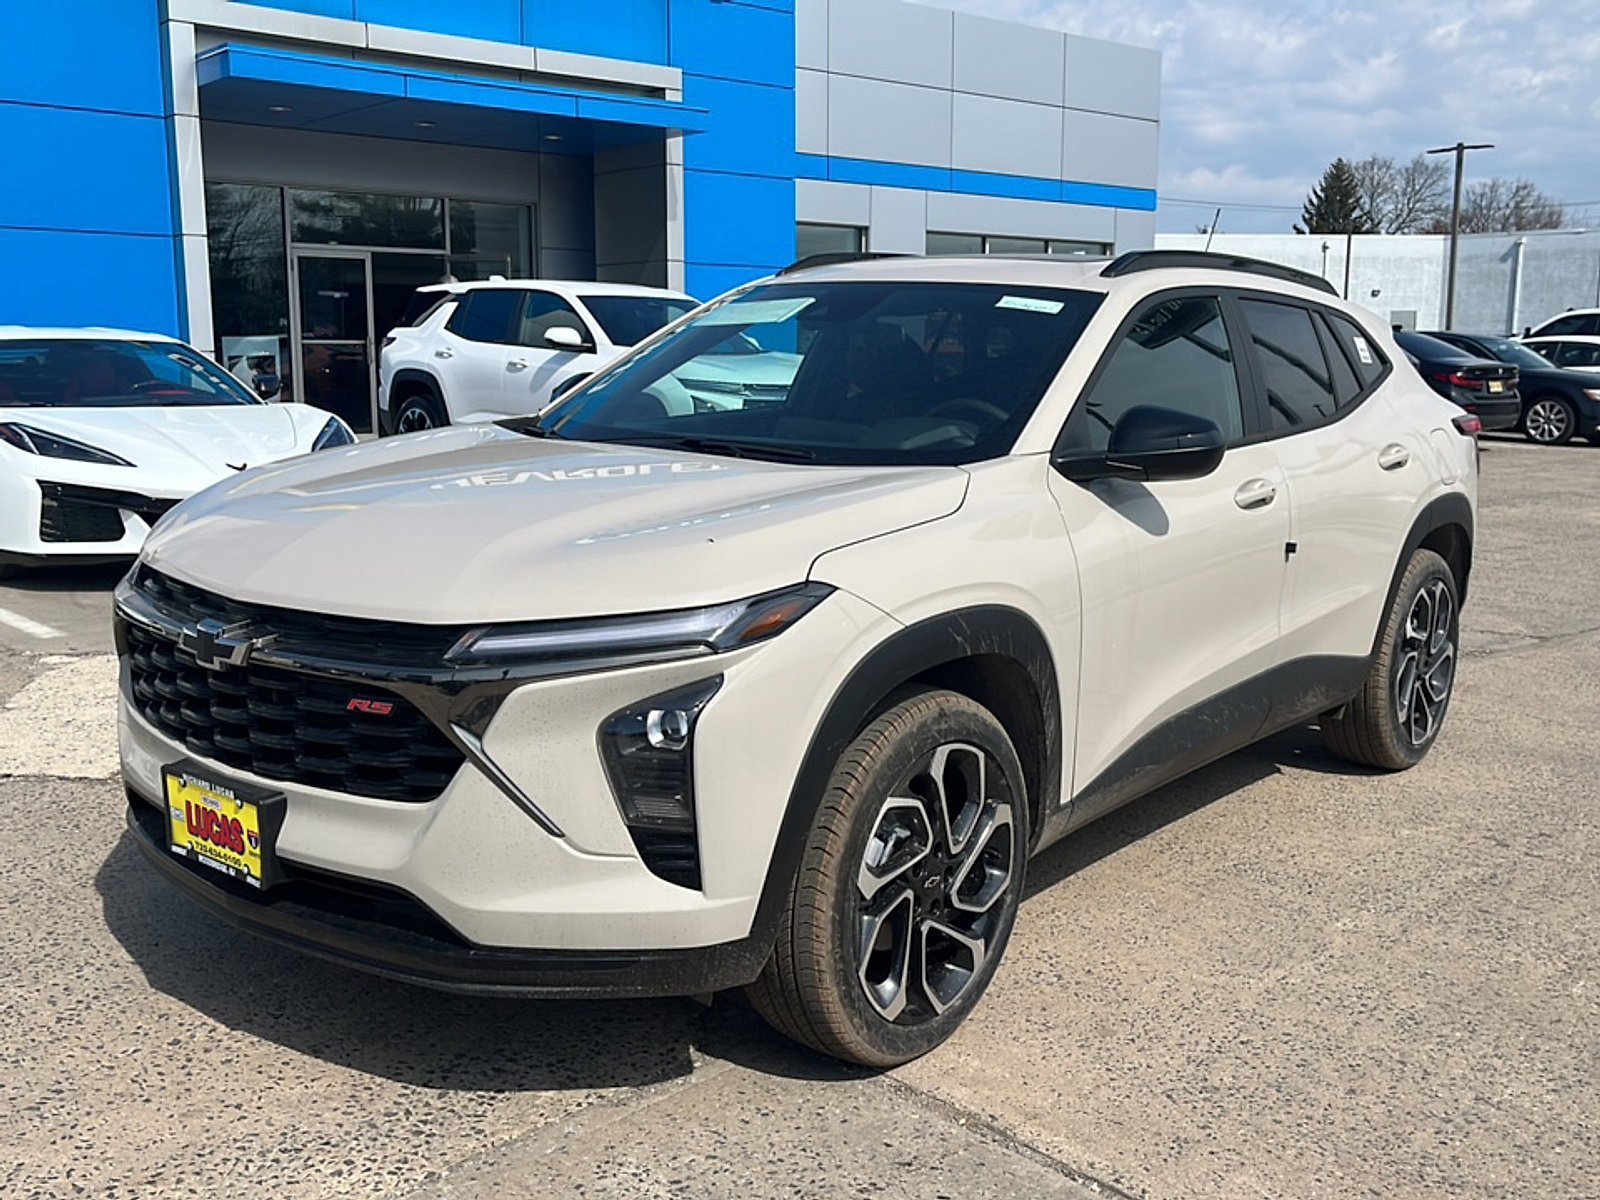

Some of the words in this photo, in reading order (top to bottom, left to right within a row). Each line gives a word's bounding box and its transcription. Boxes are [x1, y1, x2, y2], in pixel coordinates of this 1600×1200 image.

[346, 698, 394, 715] RS
[211, 783, 235, 799] LUCAS
[185, 799, 246, 855] LUCAS
